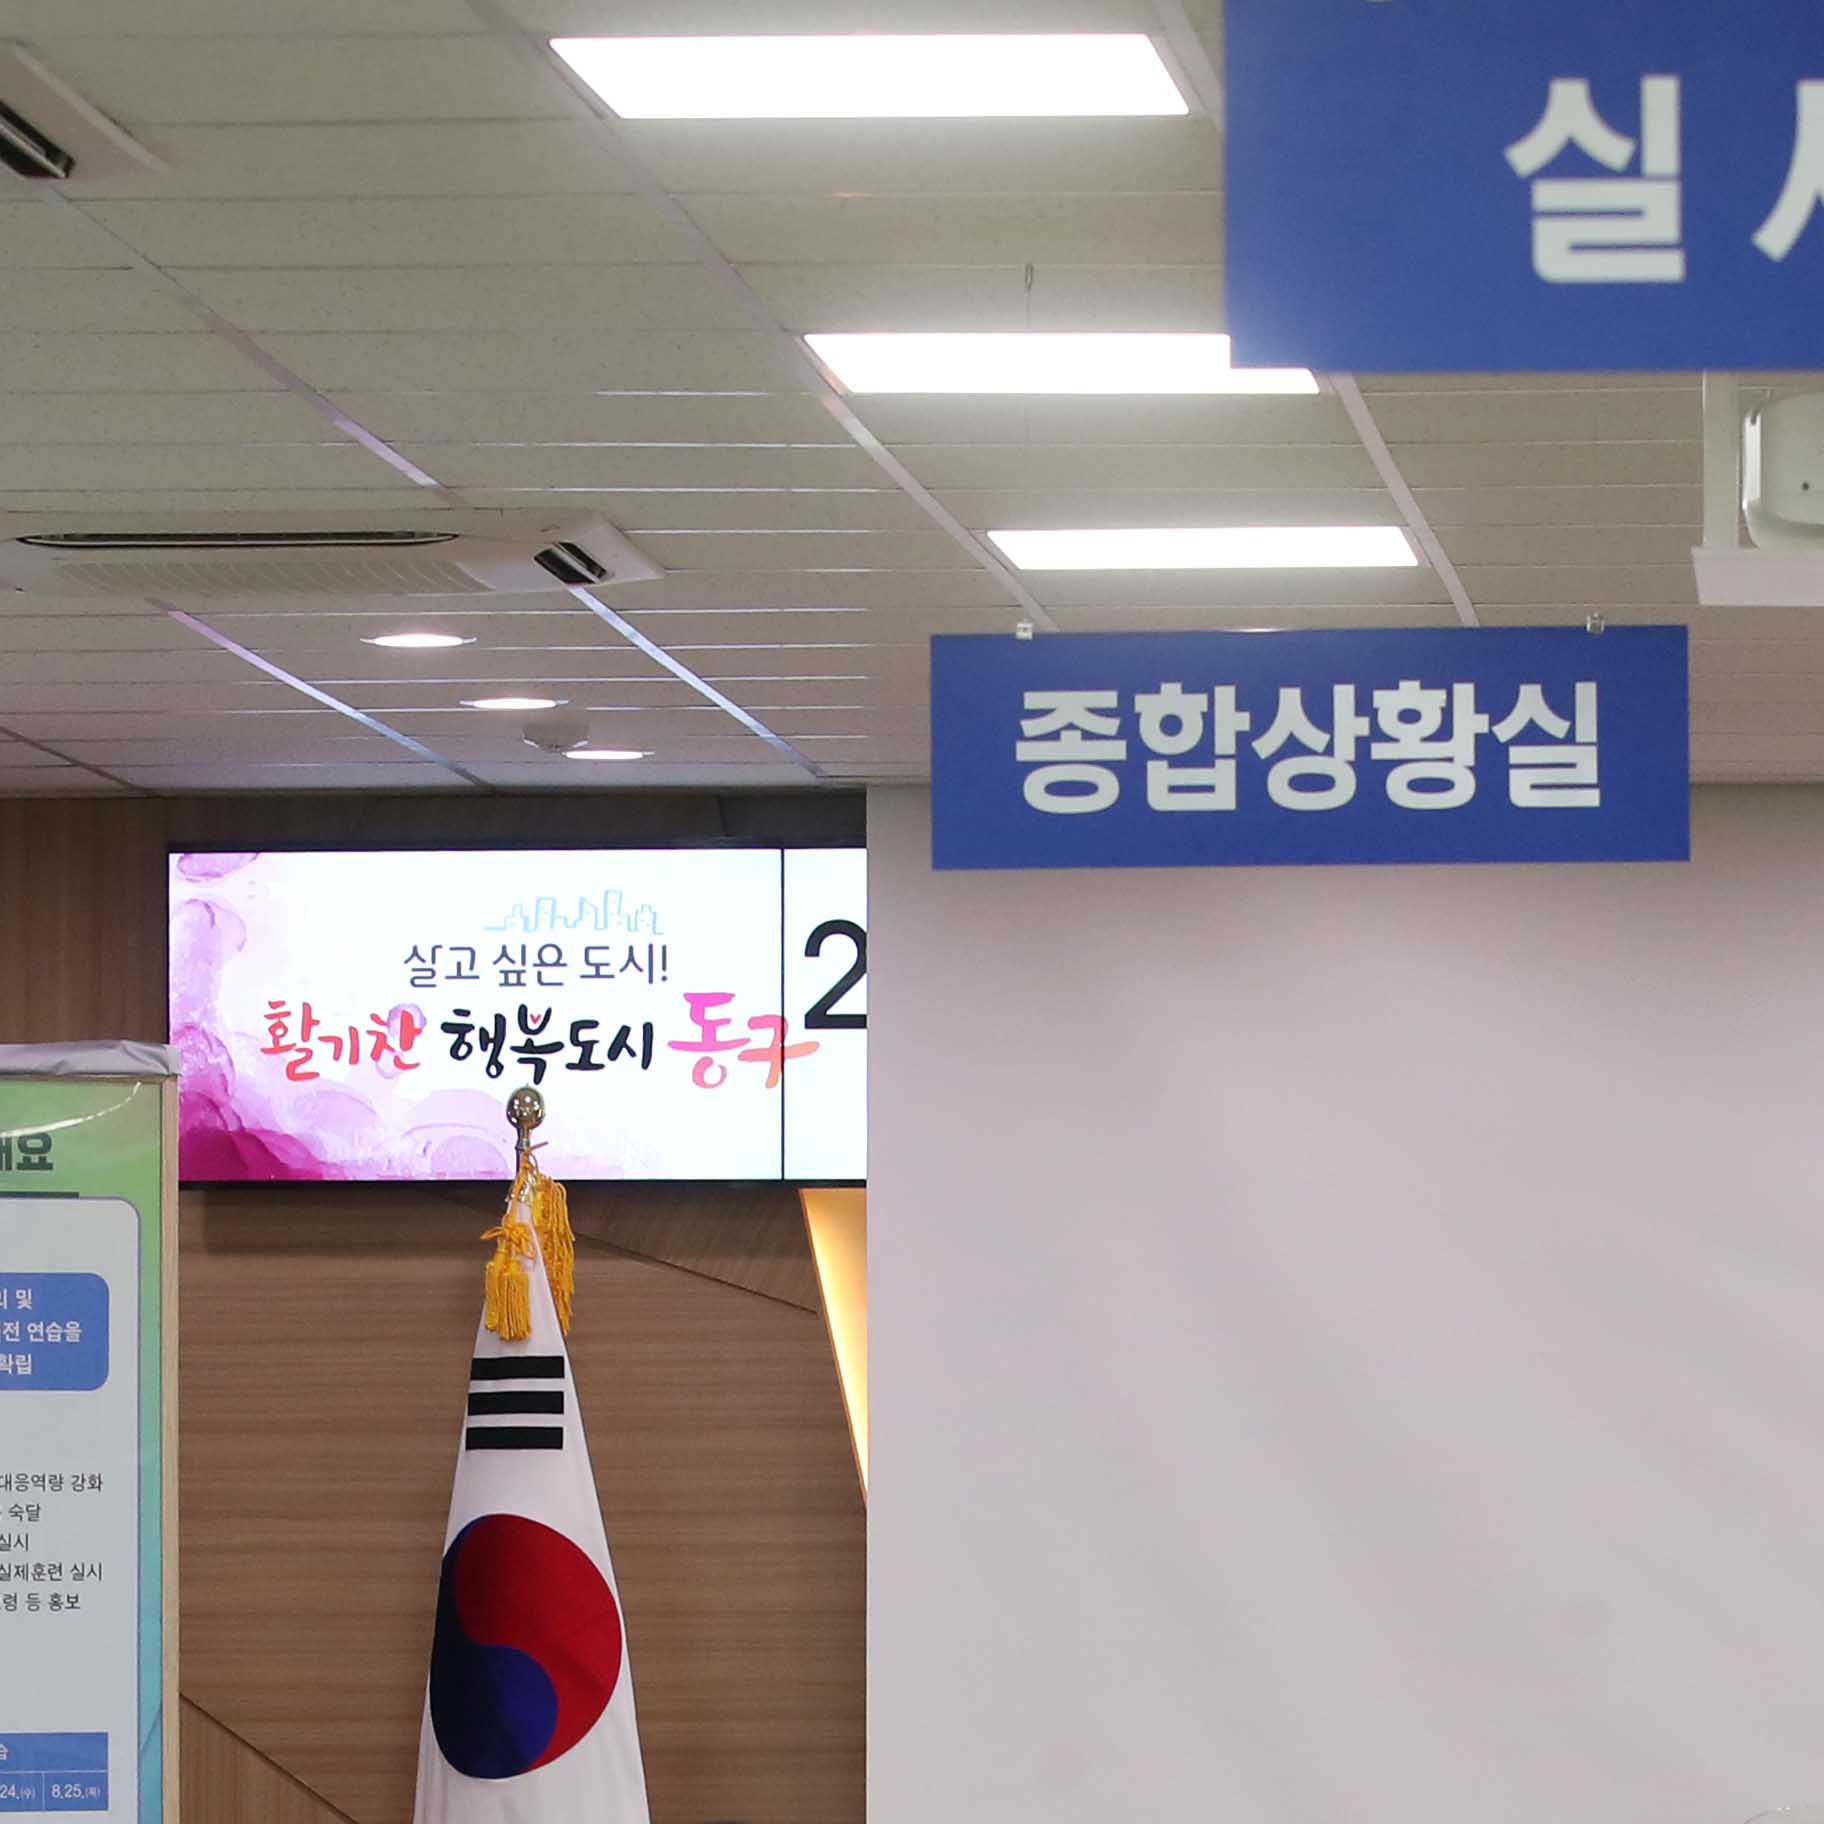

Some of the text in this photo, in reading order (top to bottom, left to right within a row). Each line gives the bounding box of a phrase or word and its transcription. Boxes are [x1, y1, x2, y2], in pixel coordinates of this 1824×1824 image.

[1015, 681, 1601, 813] 종합상황실
[402, 942, 669, 988] 살고 싶은 도시!
[259, 991, 820, 1089] 활기찬 행복도시 동구
[14, 1287, 33, 1311] 및
[27, 1320, 82, 1343] 연습을
[70, 1473, 103, 1493] 강화
[8, 1503, 41, 1523] 숙달
[69, 1563, 103, 1583] 실시
[25, 1593, 41, 1613] 등
[48, 1593, 81, 1613] 홍보
